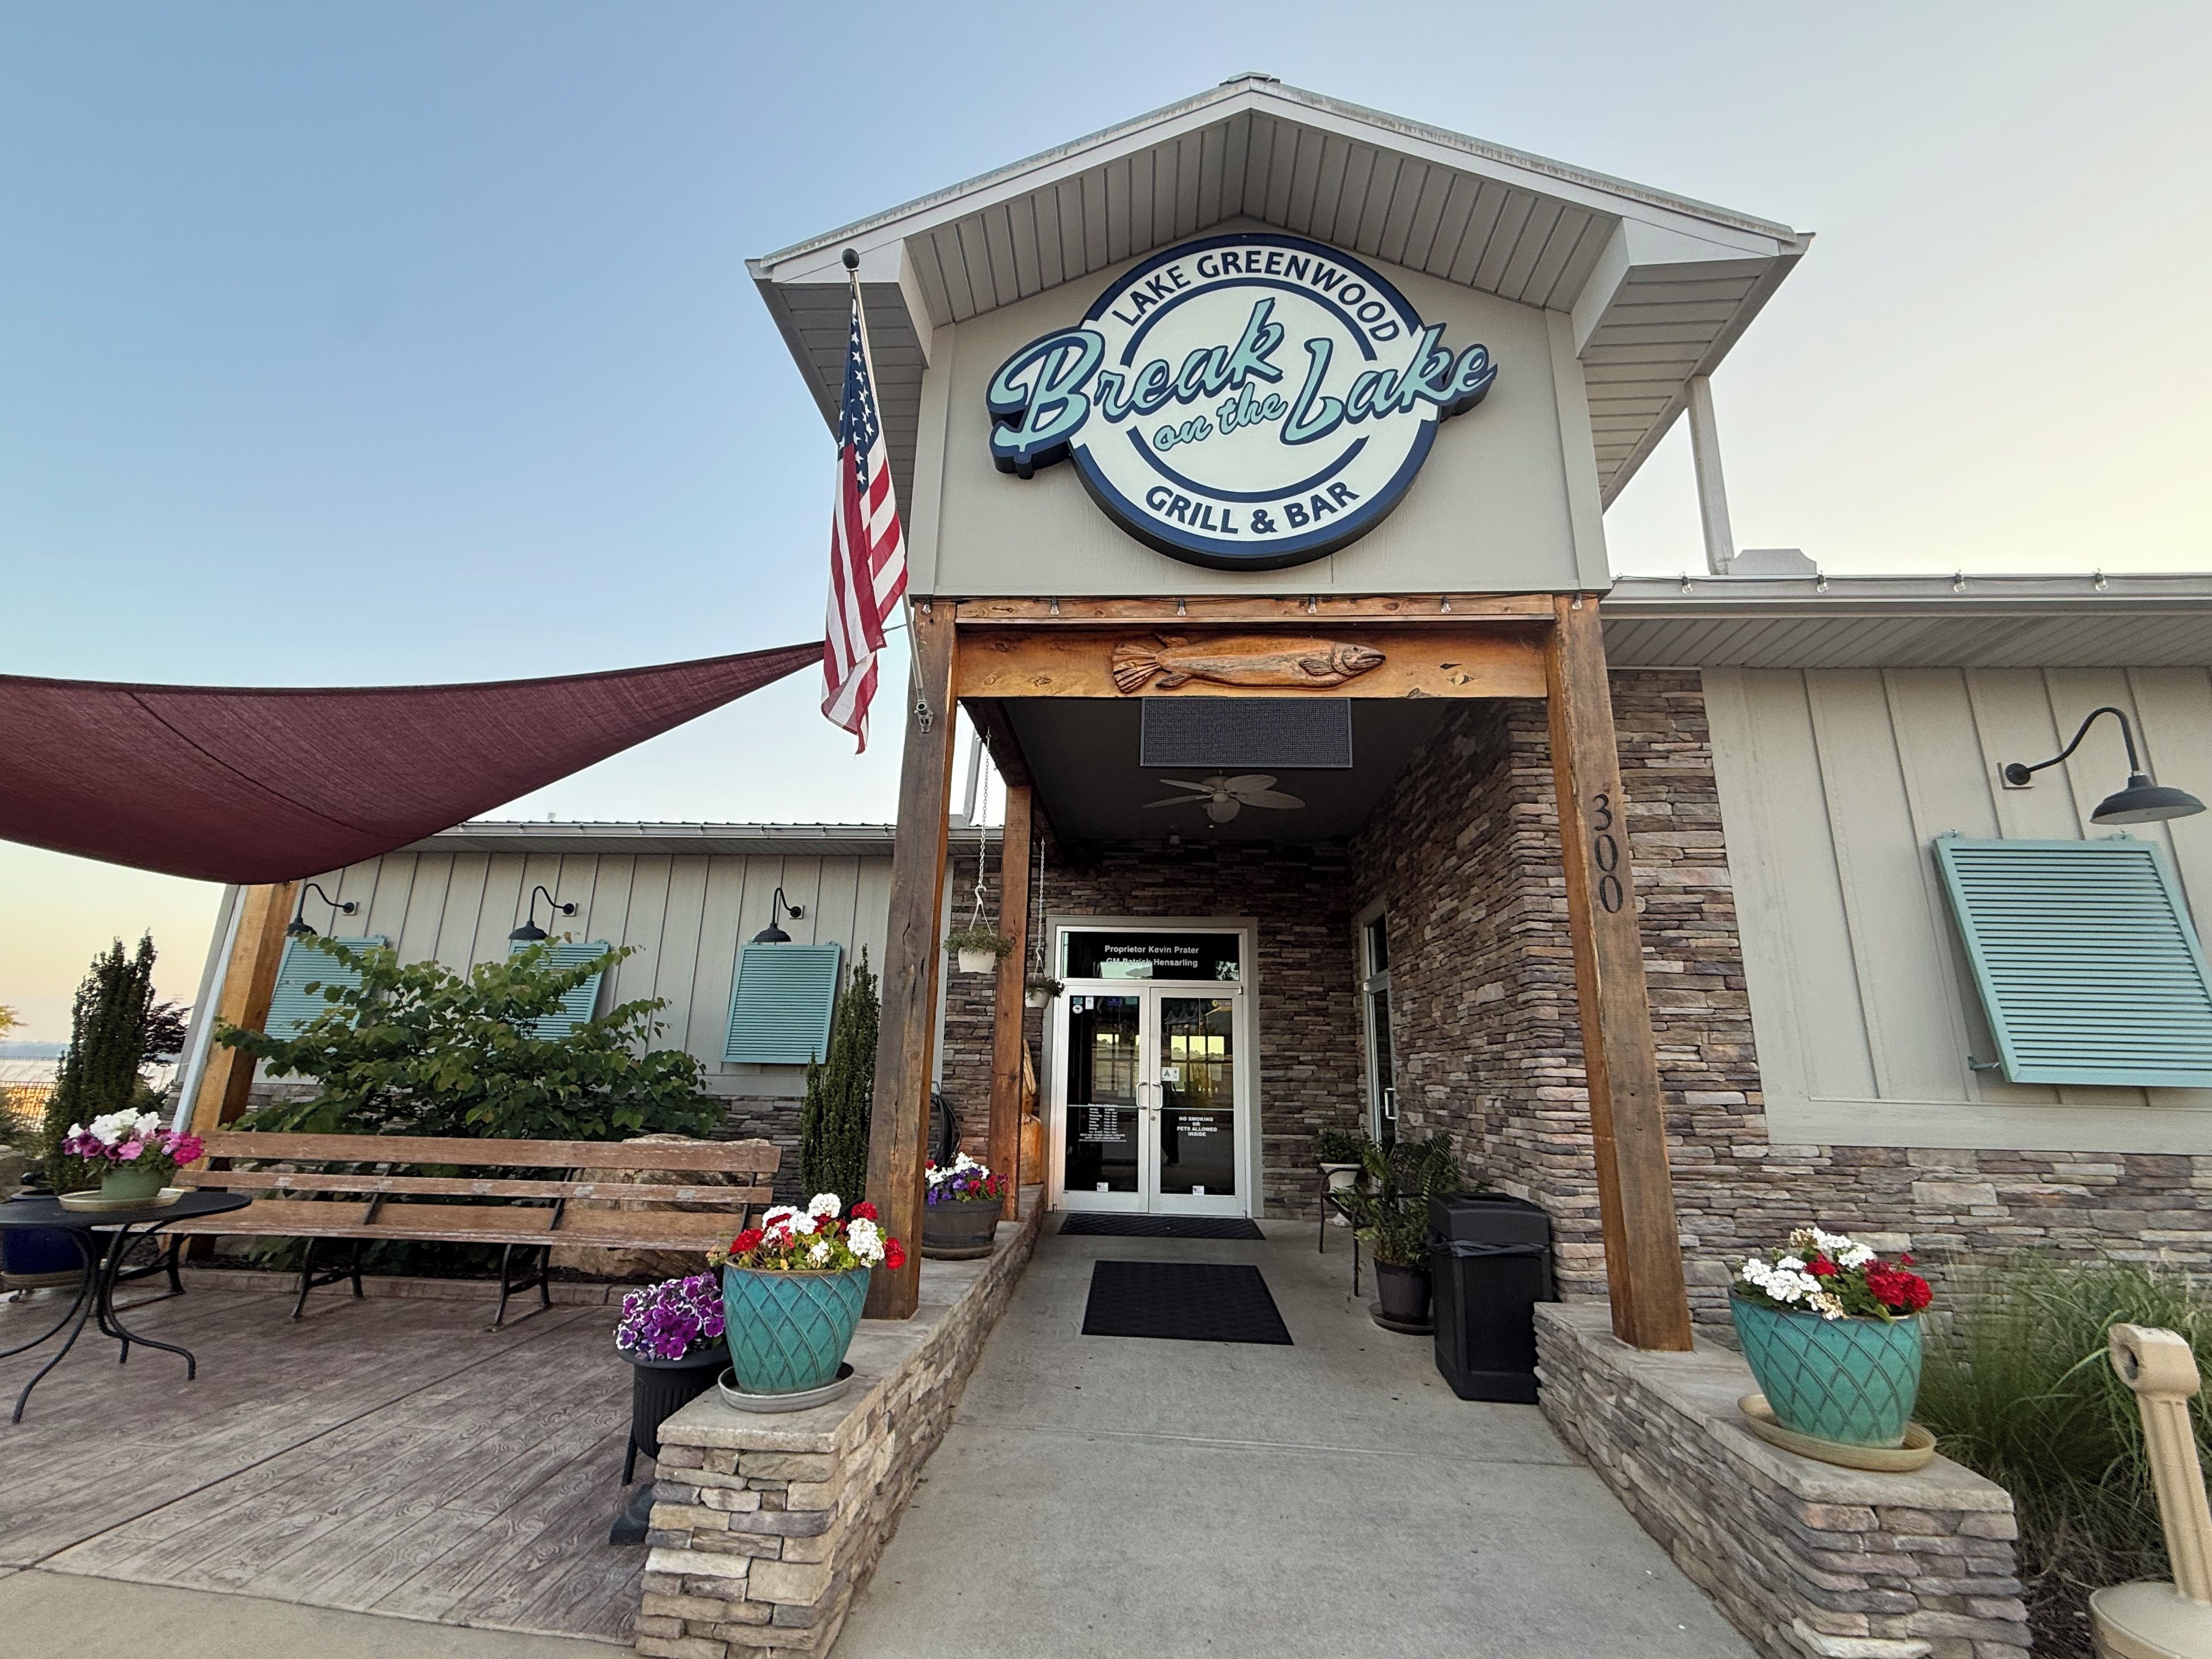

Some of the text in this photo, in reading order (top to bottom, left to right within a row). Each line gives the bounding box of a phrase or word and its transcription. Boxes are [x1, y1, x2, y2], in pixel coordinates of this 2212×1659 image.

[1111, 250, 1400, 343] LAKE GREENWOOD
[987, 296, 1285, 455] Break
[1152, 381, 1288, 452] on the
[1279, 323, 1498, 446] Lake
[1145, 480, 1361, 534] GRILL & BAR
[1593, 793, 1623, 914] 300
[1104, 945, 1199, 954] Proprietor Kevin Prater
[1153, 958, 1198, 968] Hensarling
